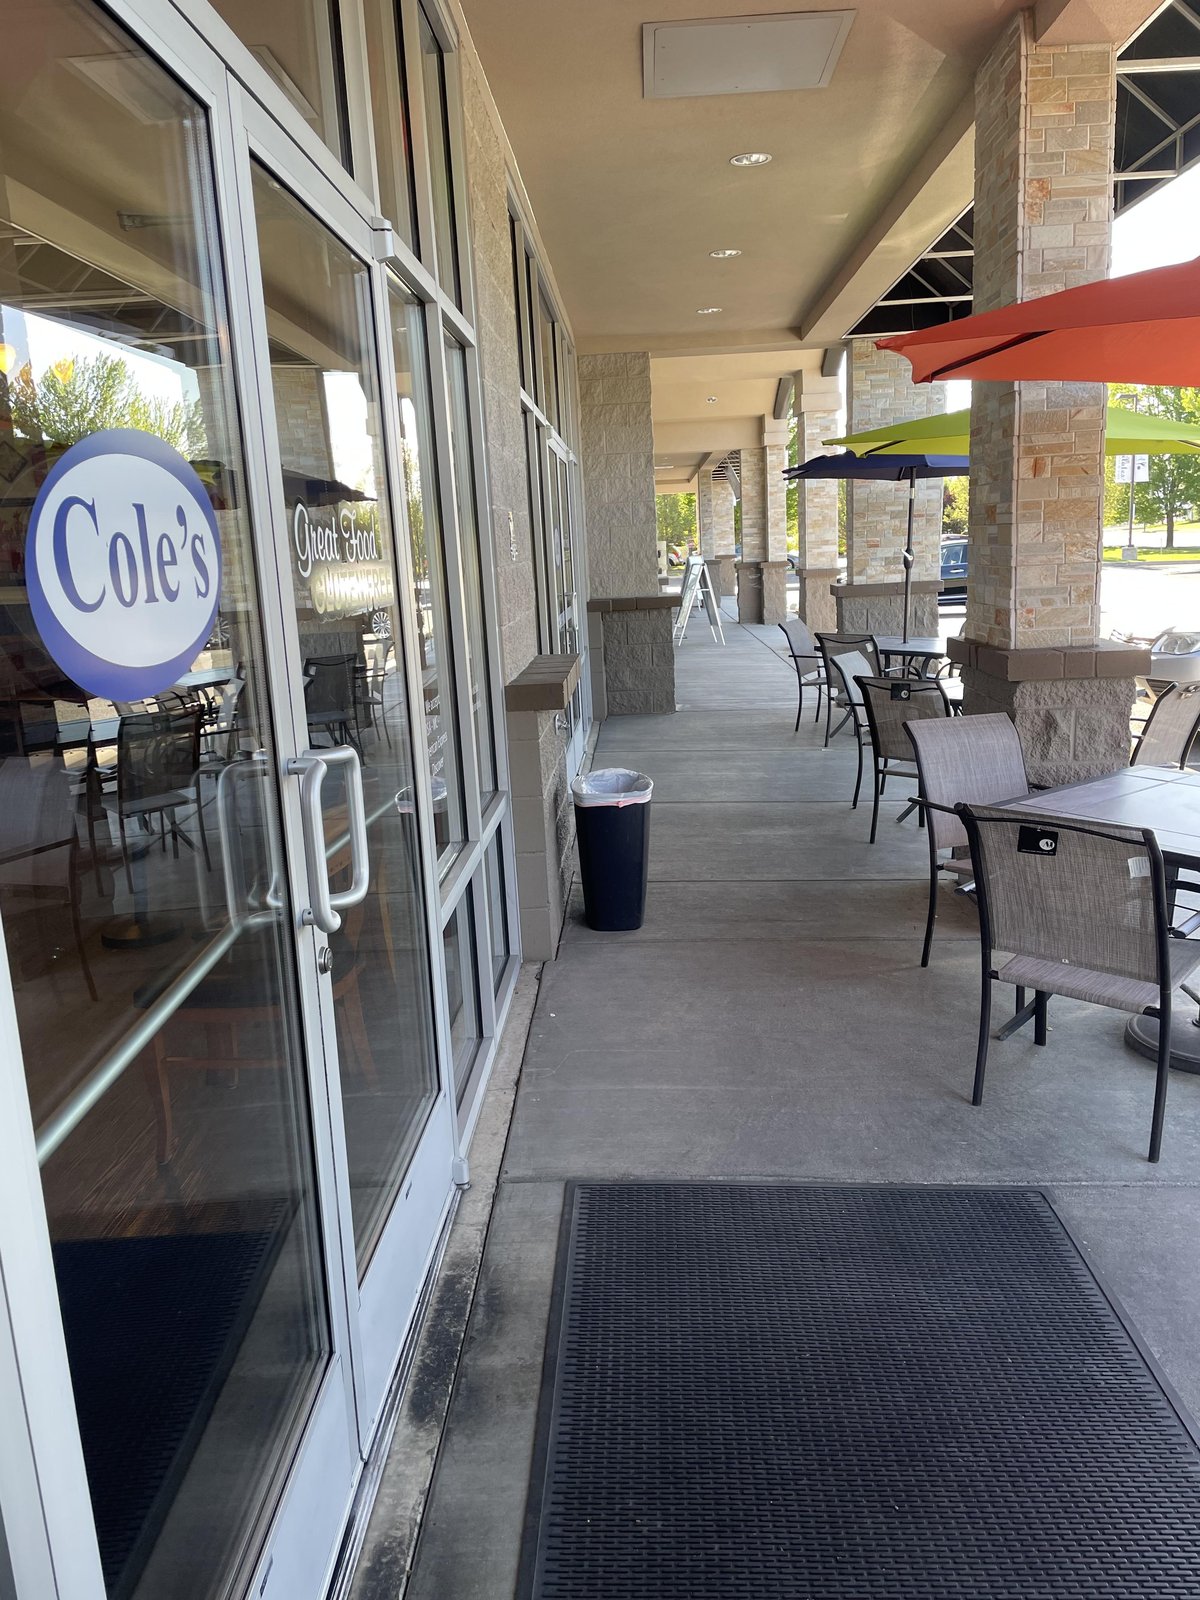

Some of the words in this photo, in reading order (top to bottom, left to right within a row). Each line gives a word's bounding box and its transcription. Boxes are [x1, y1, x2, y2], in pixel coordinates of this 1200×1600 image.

[53, 495, 210, 613] Cole's
[294, 502, 339, 578] Great
[340, 508, 378, 563] Food
